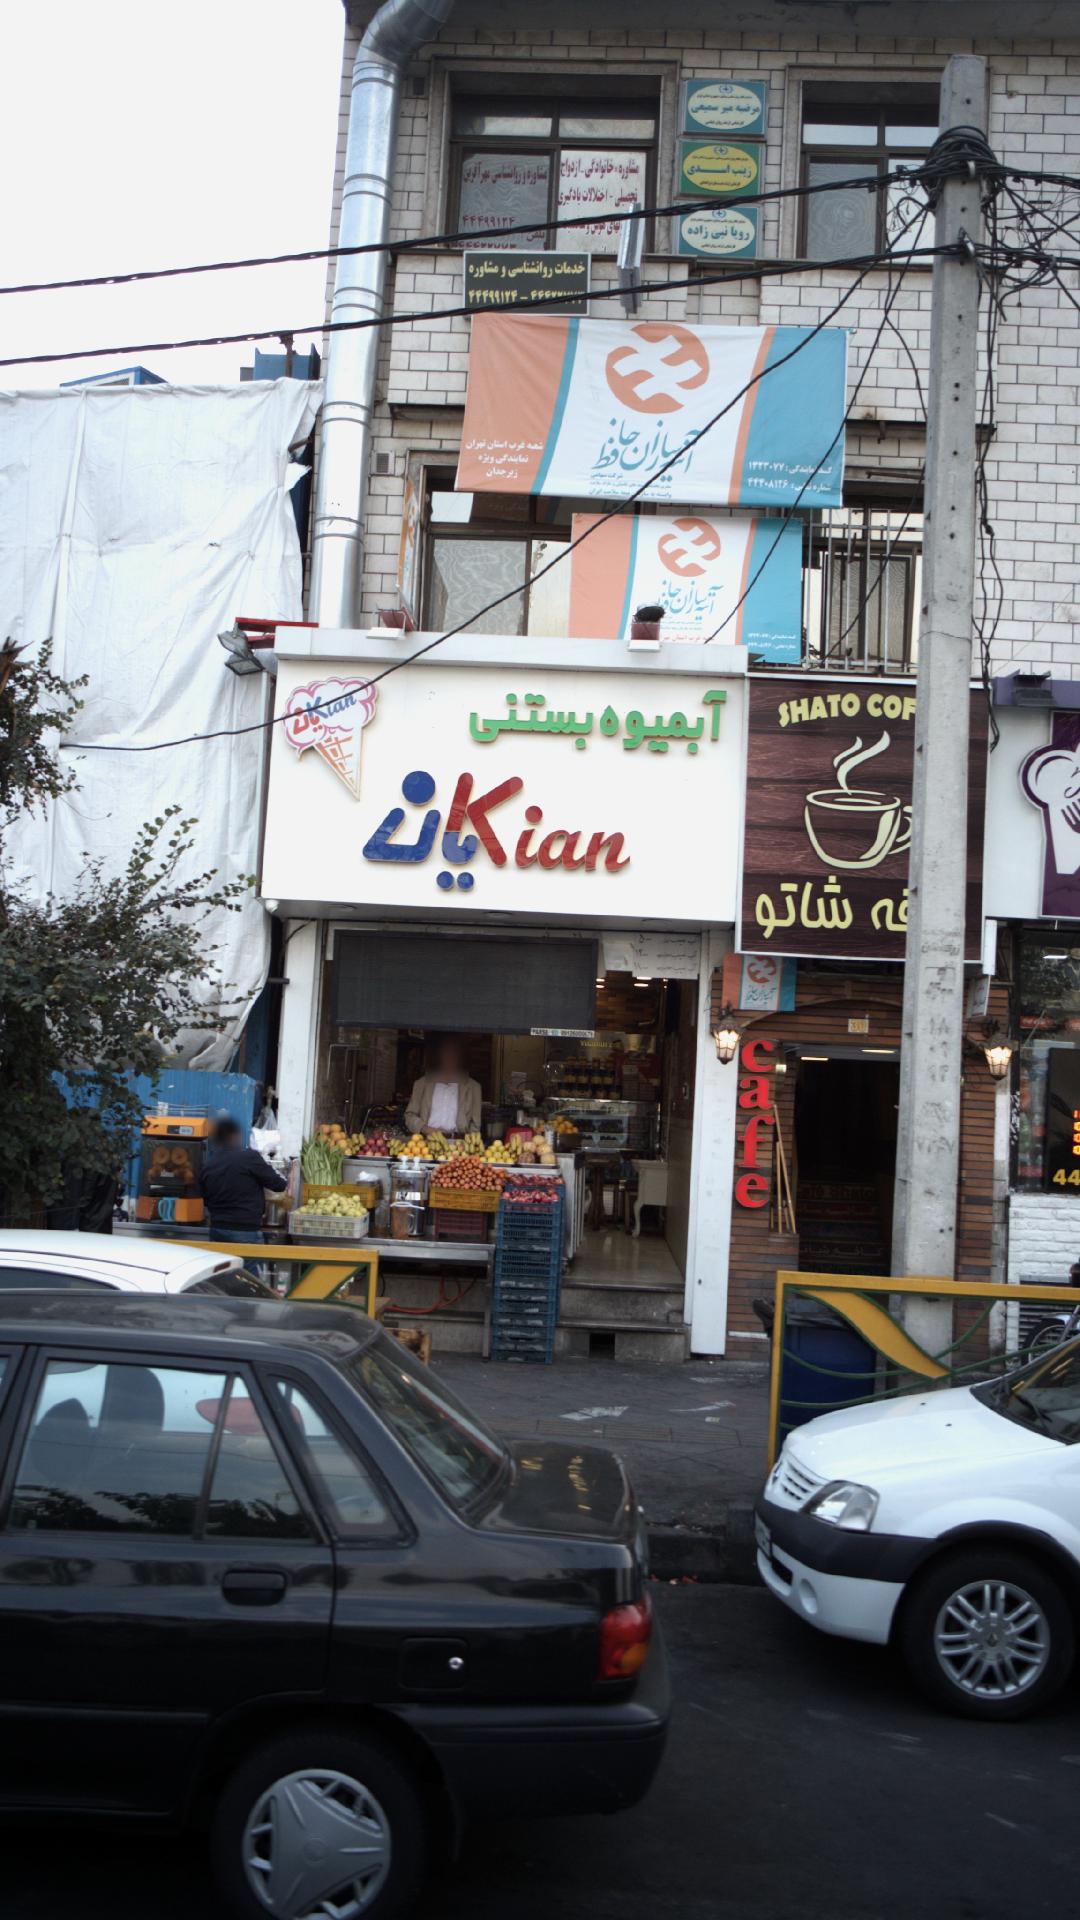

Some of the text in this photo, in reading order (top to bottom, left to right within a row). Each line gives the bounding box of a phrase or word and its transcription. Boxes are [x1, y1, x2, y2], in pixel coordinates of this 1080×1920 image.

[687, 225, 708, 239] زاده
[468, 260, 499, 278] مشاوره
[507, 260, 553, 279] روانشناسی
[554, 260, 586, 275] خدمات
[465, 440, 487, 450] تهران
[487, 440, 508, 450] استان
[508, 442, 525, 452] غرب
[307, 695, 358, 719] Kian
[778, 693, 861, 727] SHATO
[469, 690, 727, 754] آبمیوه بستنی
[446, 772, 631, 873] Kian
[755, 875, 854, 939] شاتو
[735, 1039, 776, 1209] cafe
